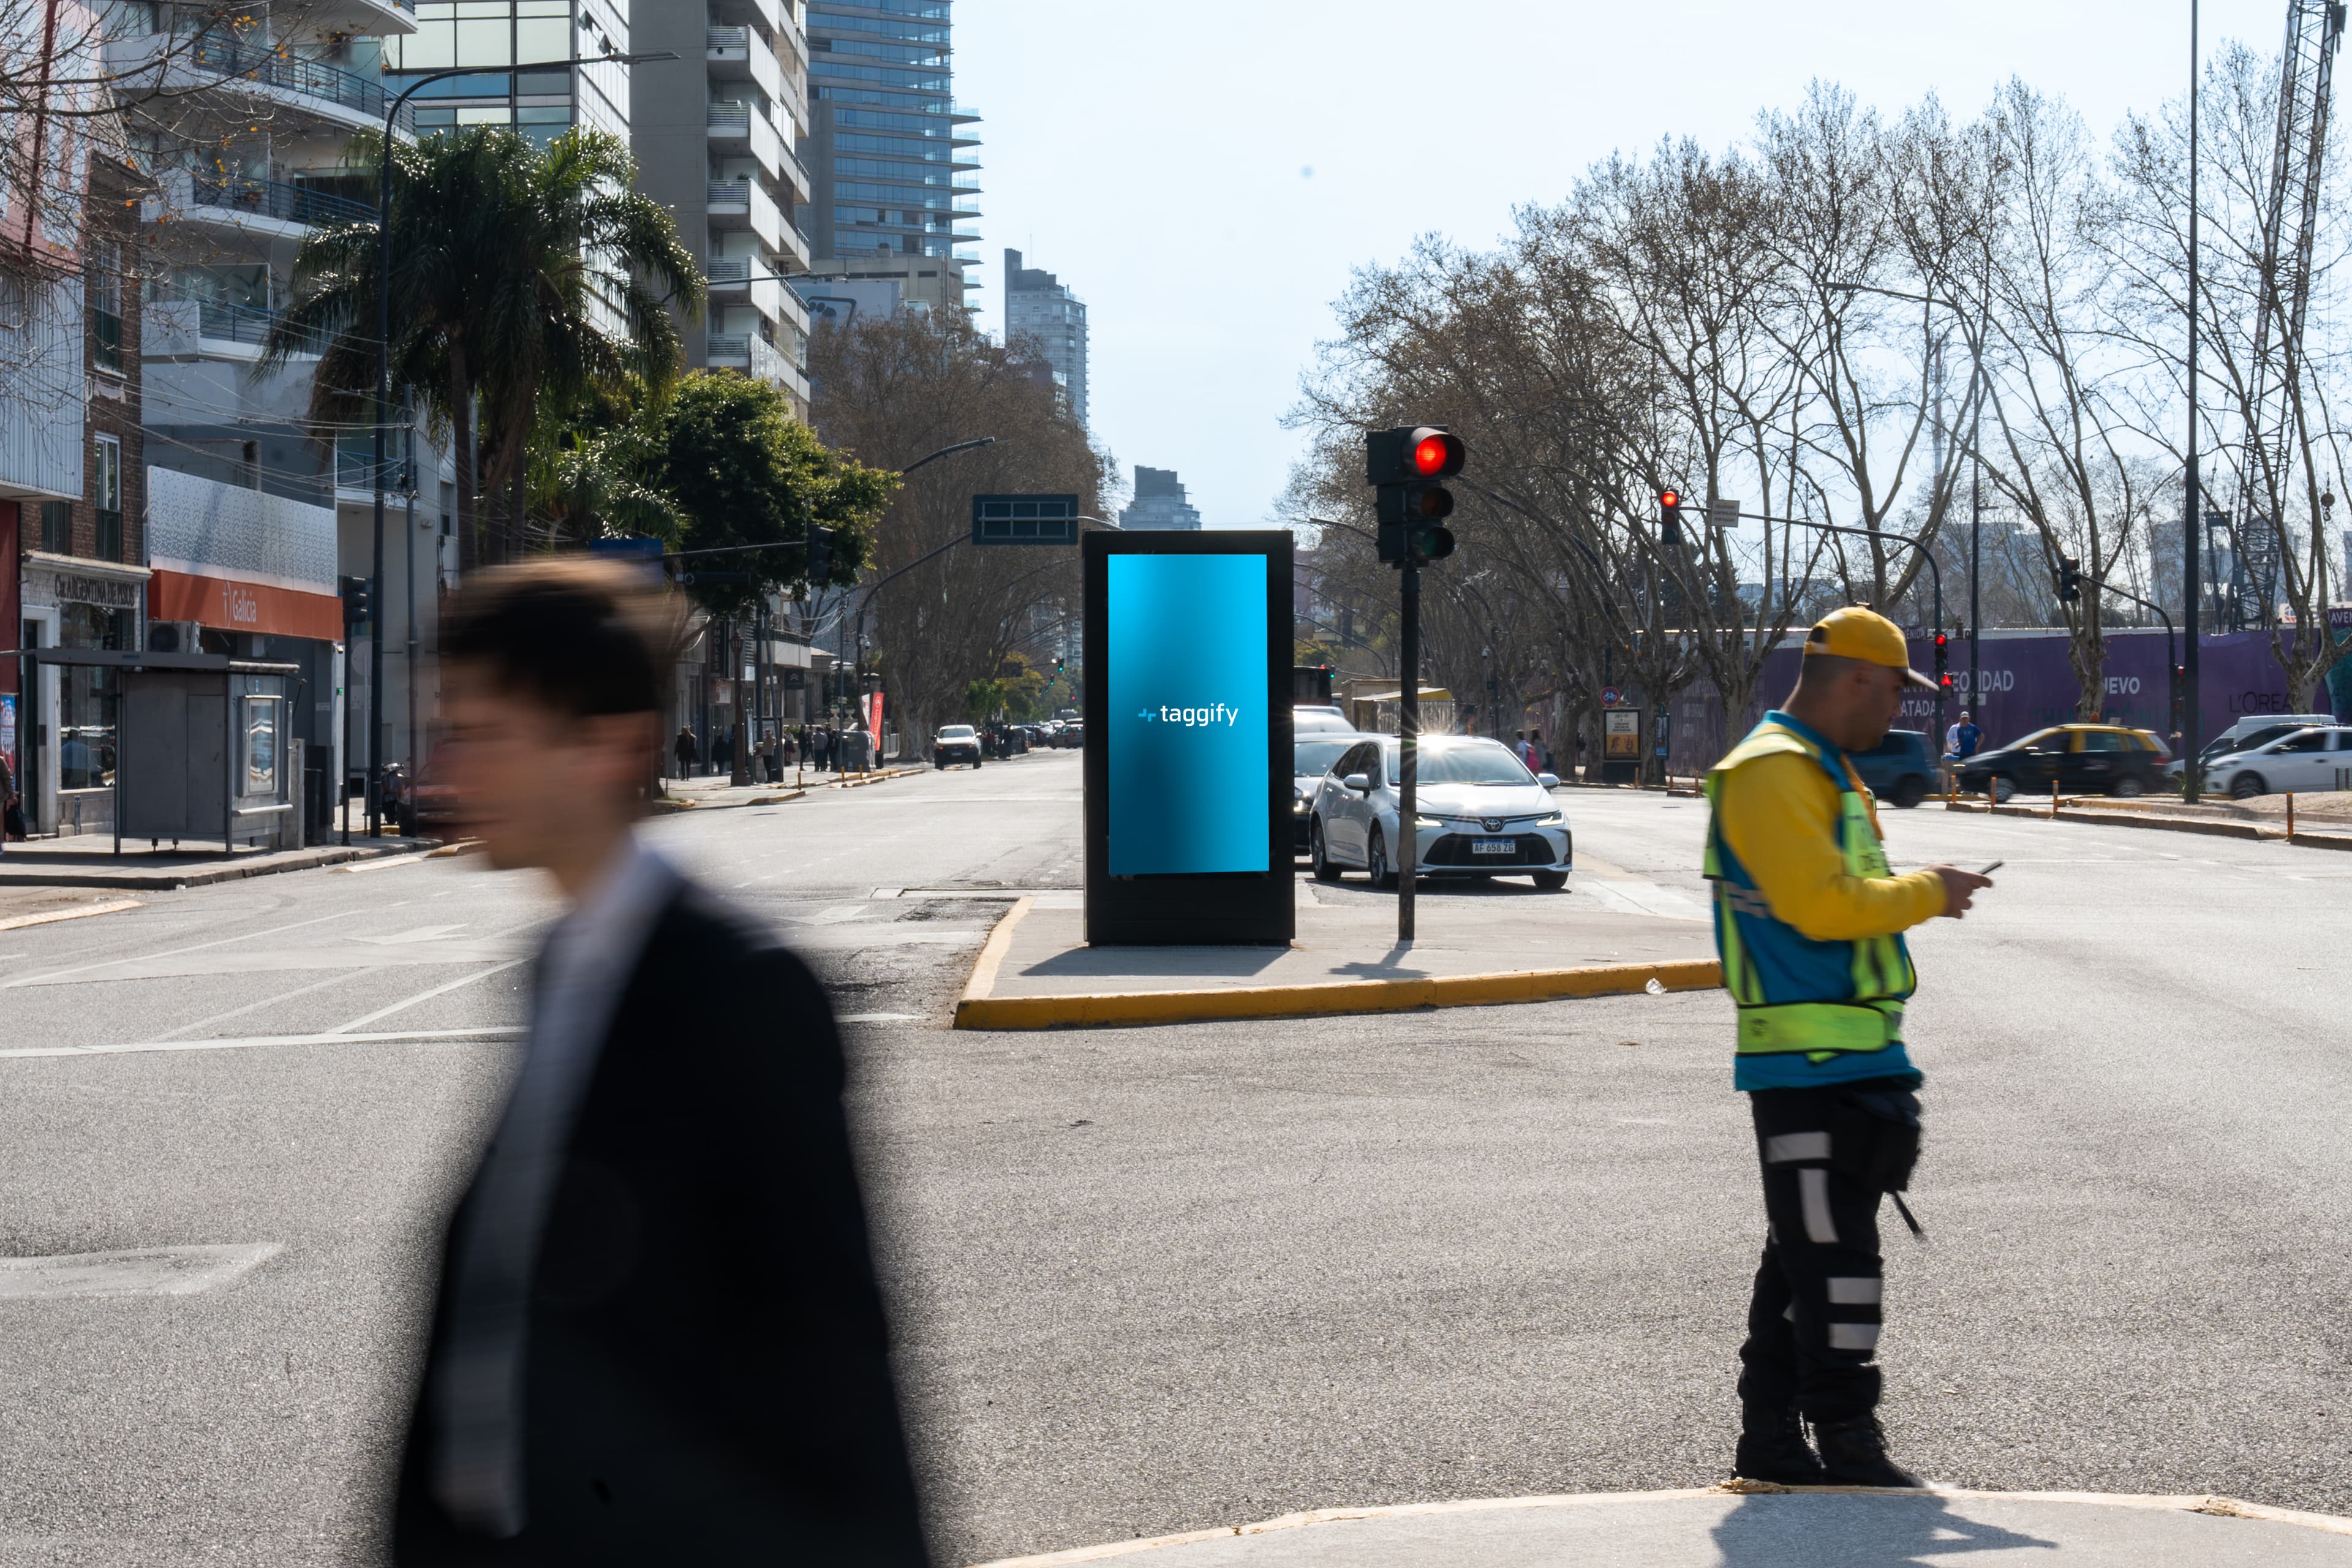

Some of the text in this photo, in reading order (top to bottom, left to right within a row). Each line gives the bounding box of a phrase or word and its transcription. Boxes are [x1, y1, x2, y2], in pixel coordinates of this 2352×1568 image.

[67, 576, 107, 604] ARGENTINA
[233, 589, 257, 623] Galicia
[2229, 691, 2293, 714] L'ORÉA
[1160, 703, 1238, 726] taggify
[1474, 844, 1484, 853] AF
[1487, 844, 1501, 853] 658
